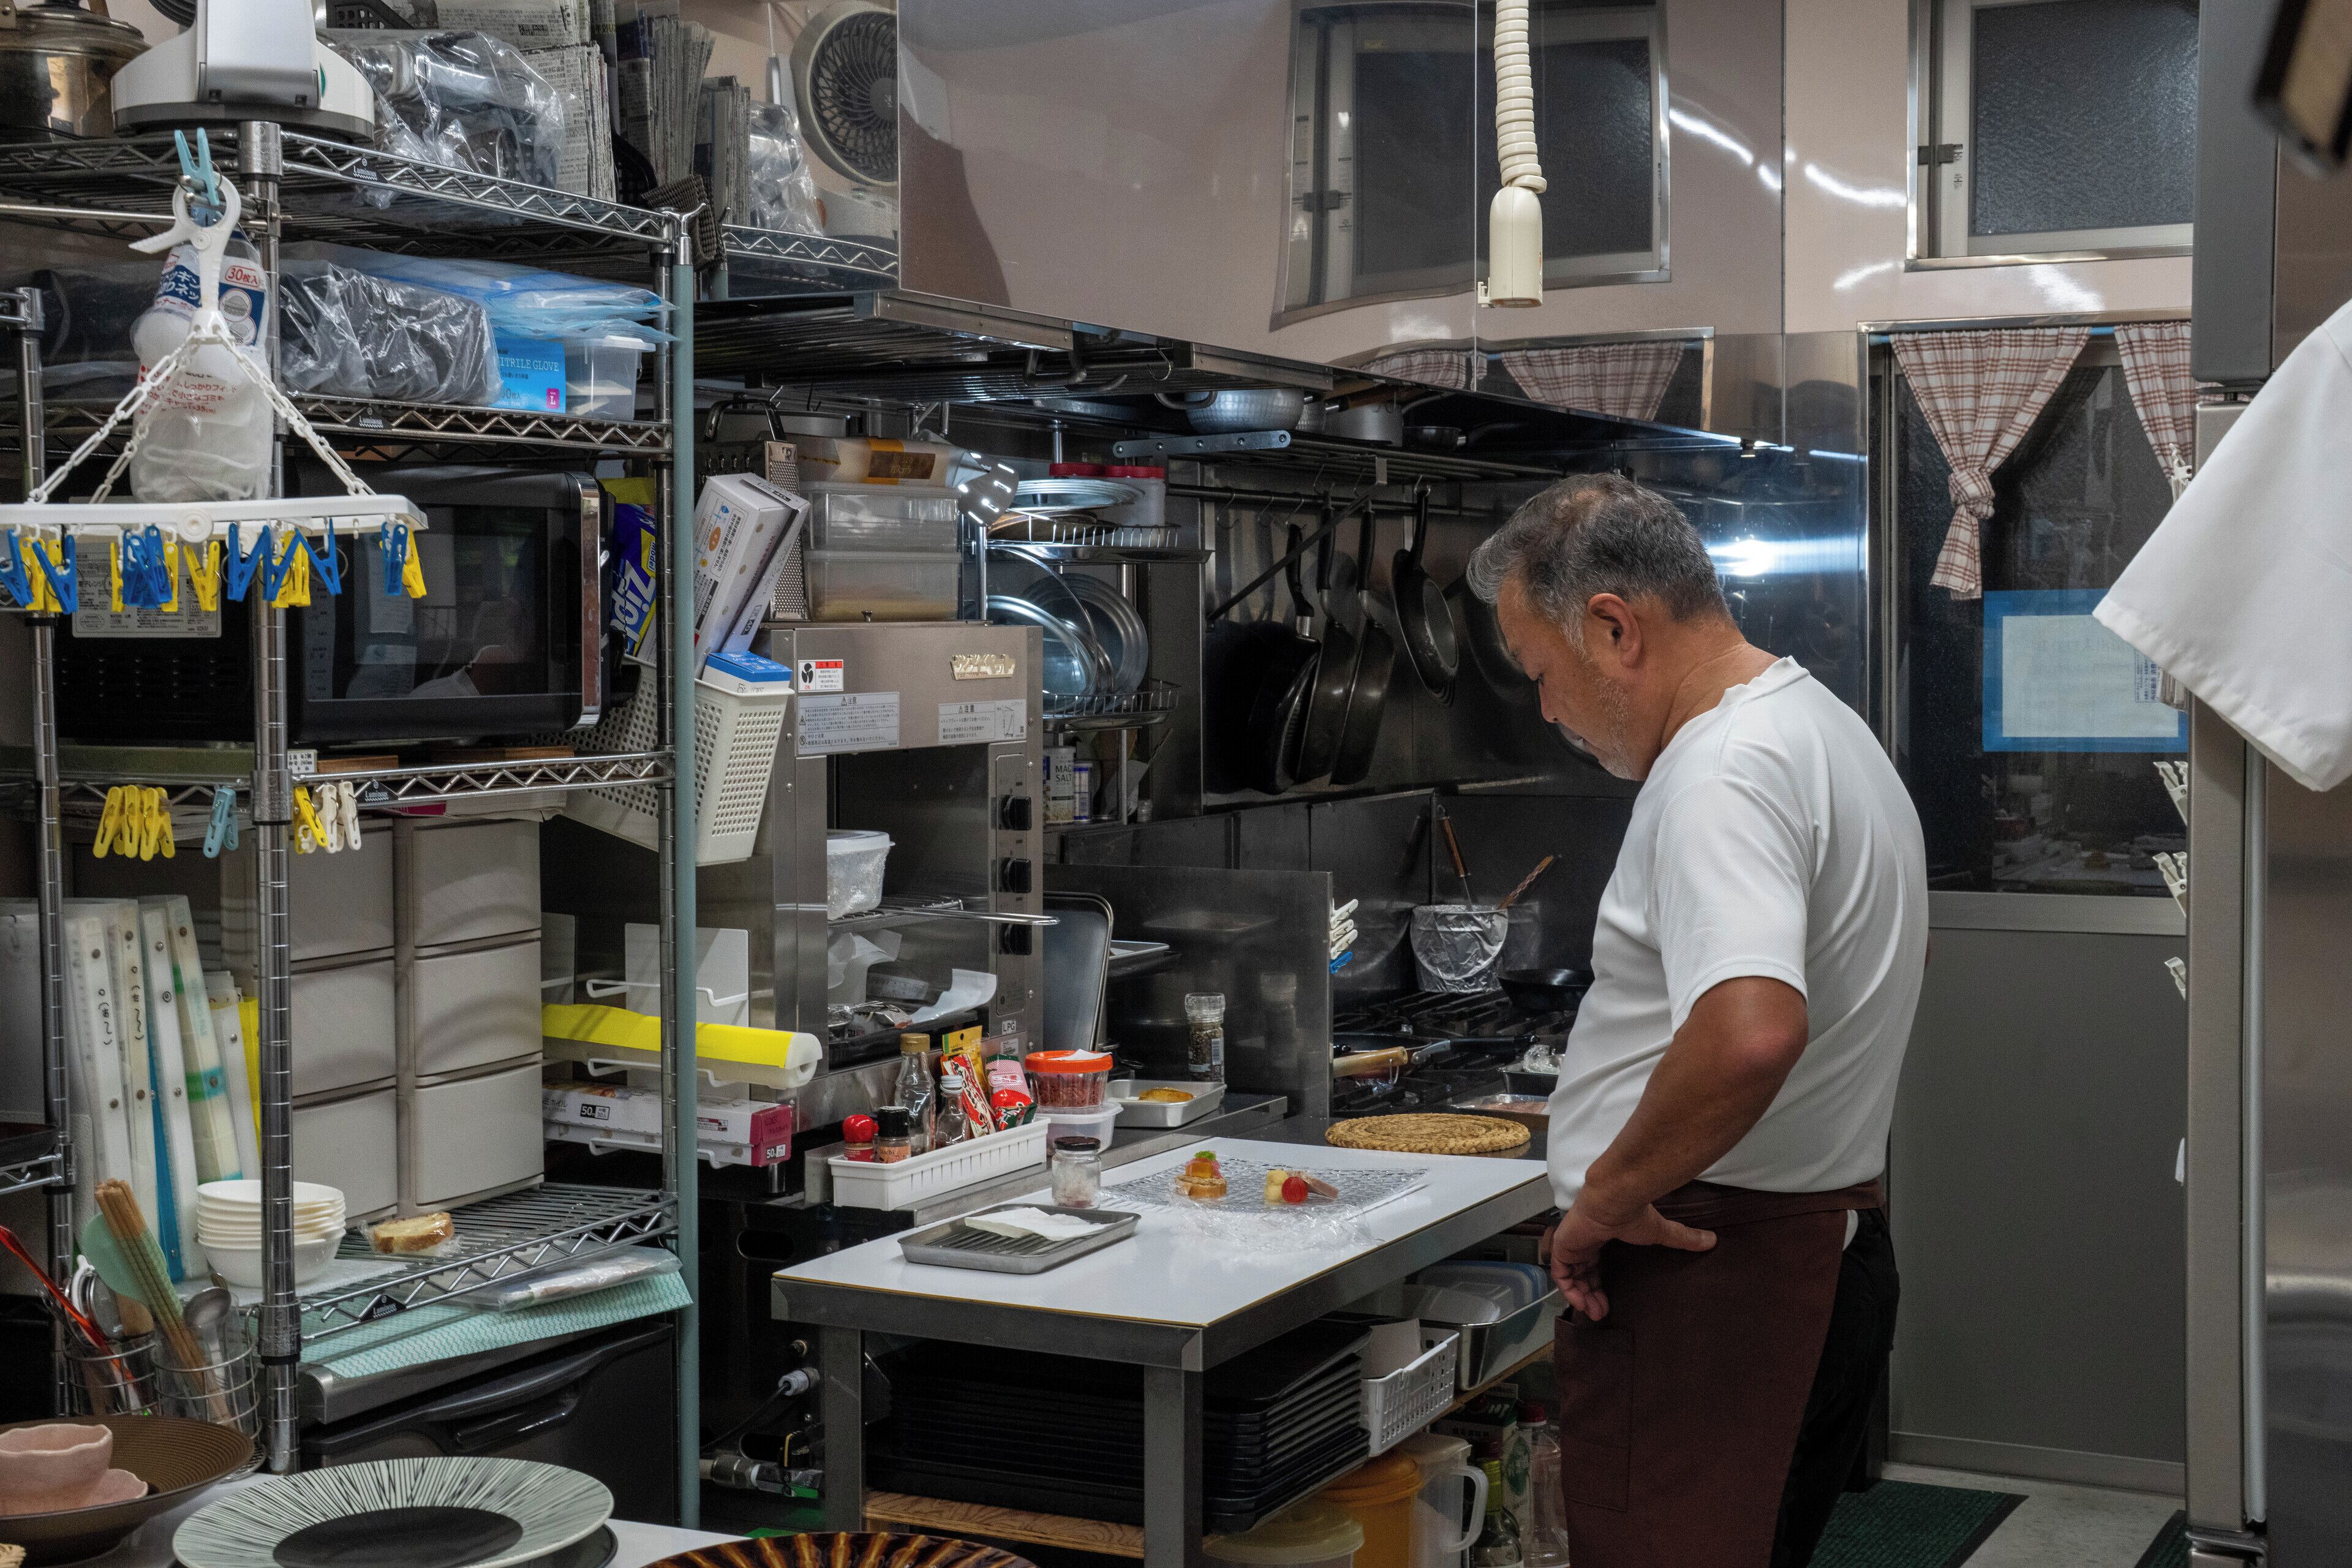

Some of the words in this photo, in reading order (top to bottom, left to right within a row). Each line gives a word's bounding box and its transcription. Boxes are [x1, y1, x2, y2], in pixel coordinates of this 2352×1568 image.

[500, 357, 531, 369] ITRILE
[532, 360, 559, 372] GLOVE
[550, 395, 556, 405] L
[609, 560, 656, 643] Zipl
[848, 696, 857, 705] 注意
[964, 704, 974, 713] 注意
[1056, 774, 1072, 782] SALT
[1003, 1022, 1016, 1032] LPG
